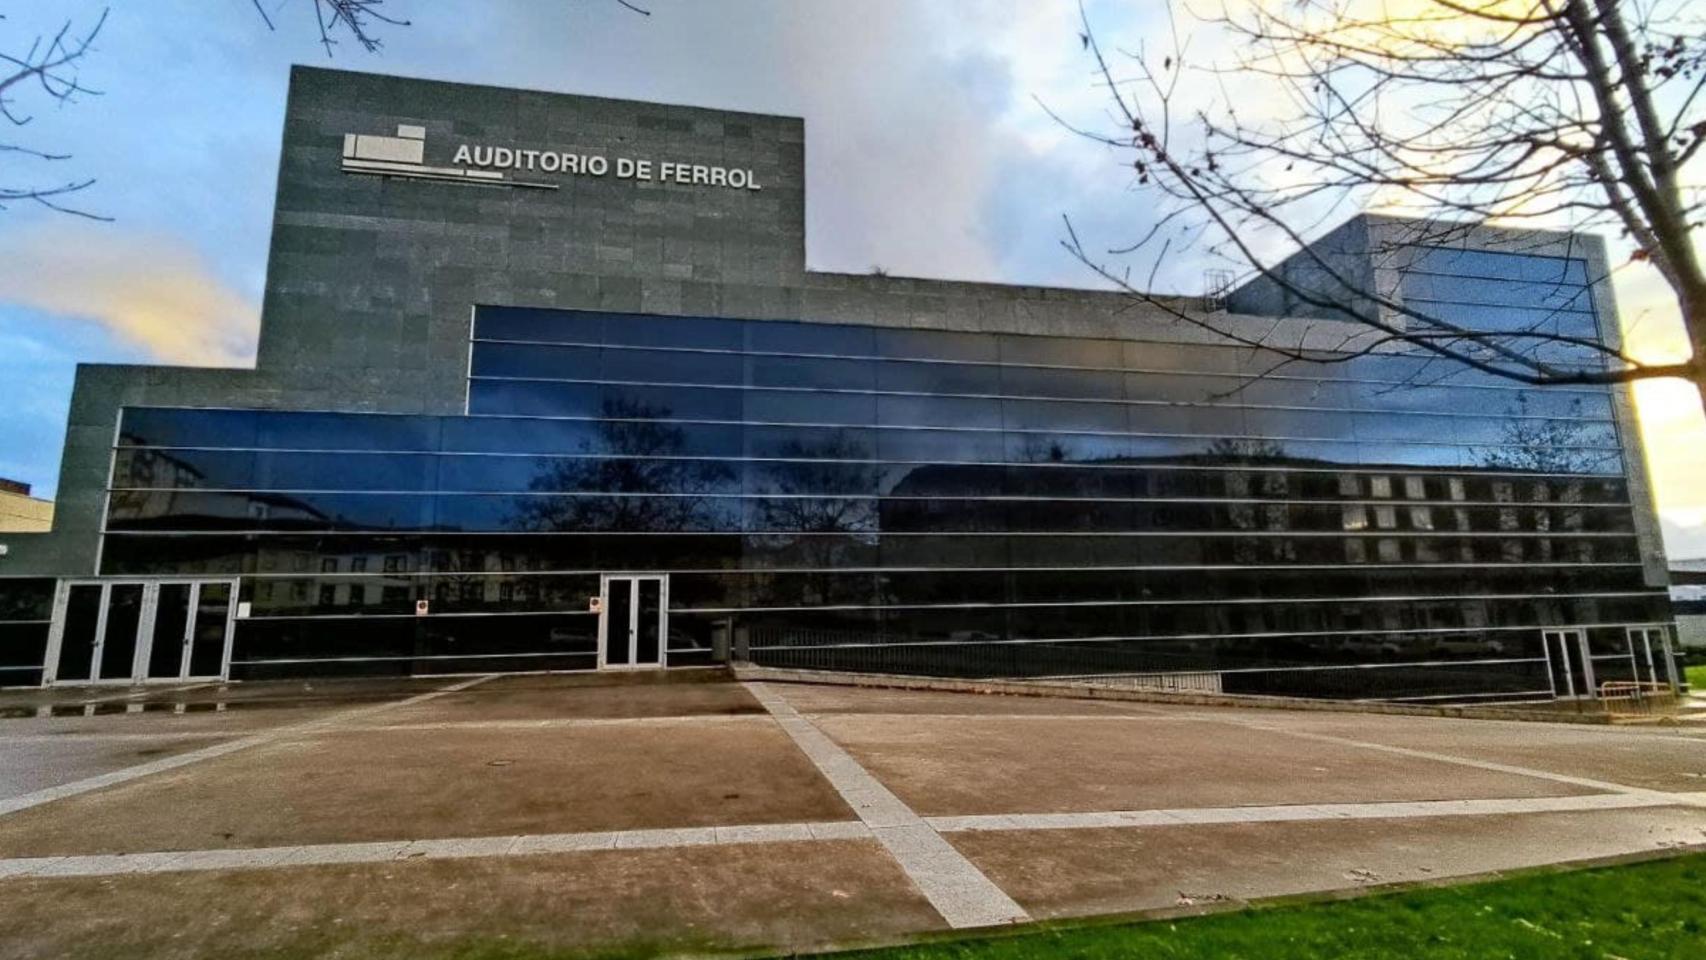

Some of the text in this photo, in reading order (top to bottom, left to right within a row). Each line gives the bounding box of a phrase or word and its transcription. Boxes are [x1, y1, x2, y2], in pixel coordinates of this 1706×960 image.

[453, 145, 761, 190] AUDITORIO DE FERROL
